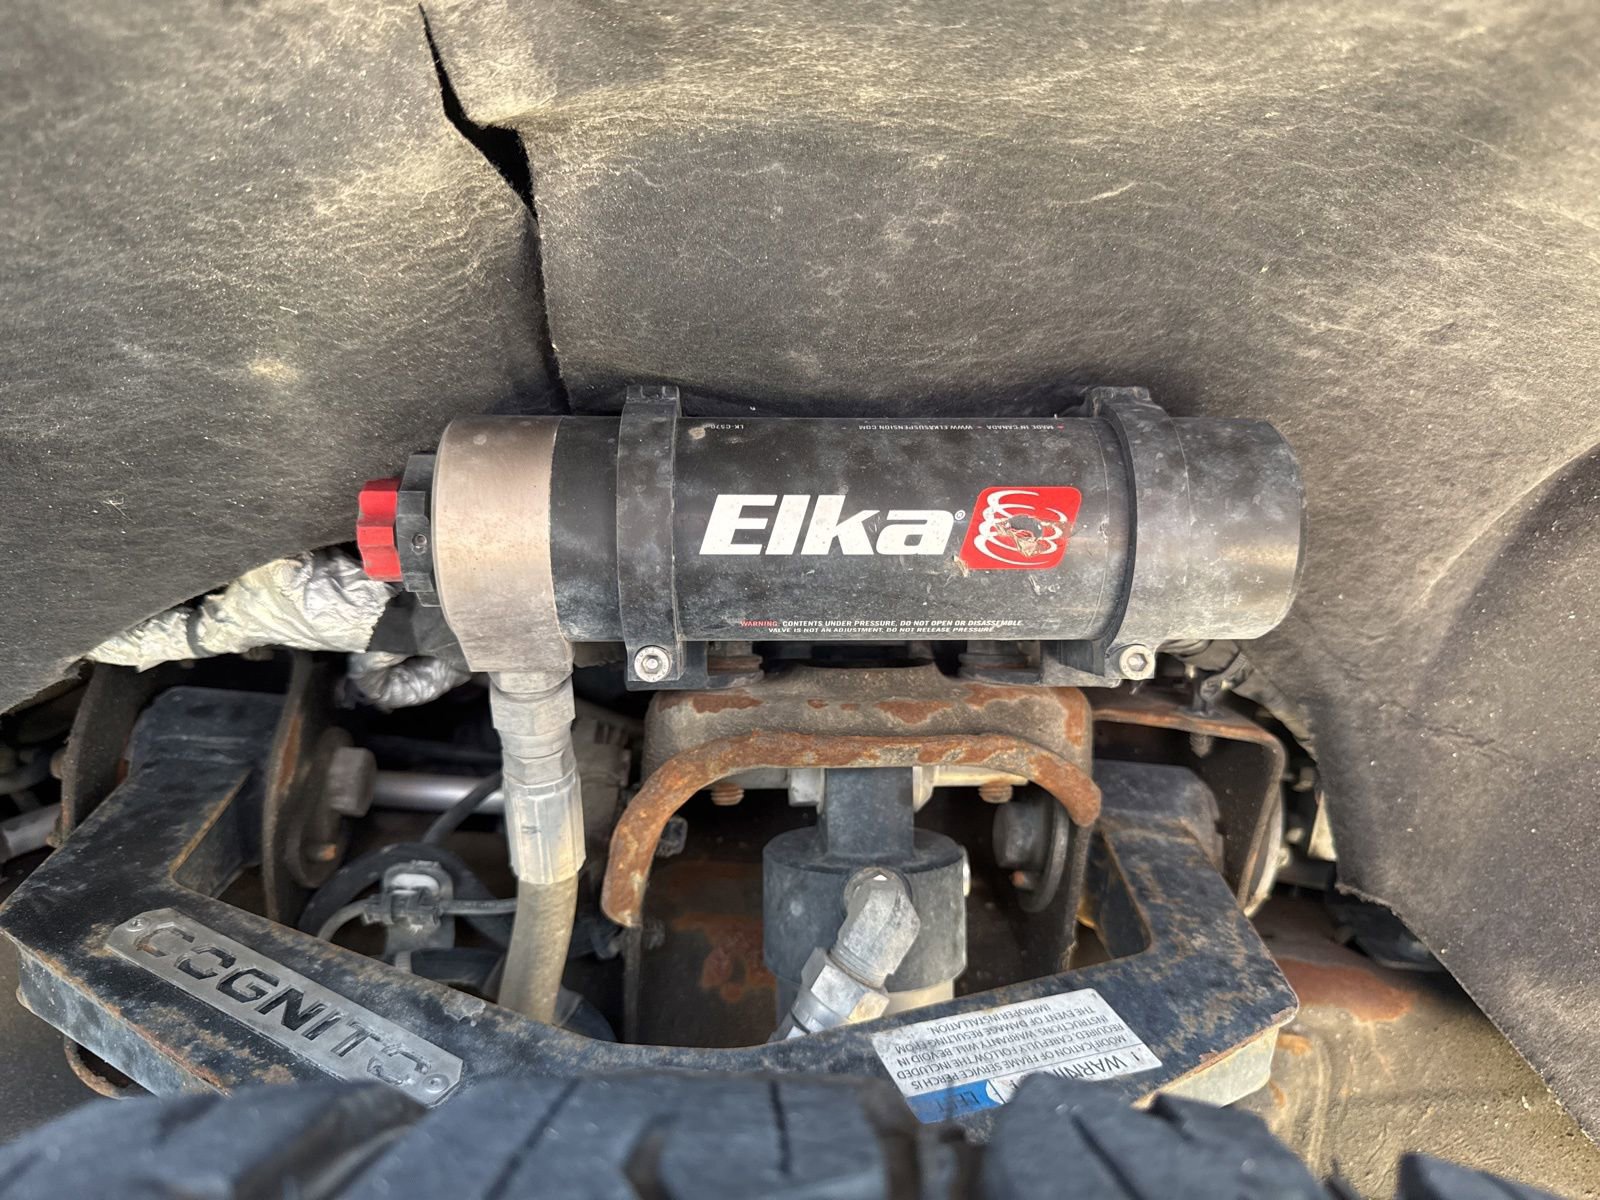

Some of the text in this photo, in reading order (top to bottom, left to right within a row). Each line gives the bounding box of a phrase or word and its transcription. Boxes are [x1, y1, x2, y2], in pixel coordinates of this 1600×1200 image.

[699, 494, 954, 555] Elka
[1000, 1003, 1051, 1019] IMPROPER
[895, 1006, 1095, 1055] THE EVENT OF DAMAGE RESULTING FROM
[980, 1030, 1037, 1048] WARRANTY
[952, 1043, 980, 1054] WILL
[1019, 1035, 1073, 1052] CAREFULLY
[911, 1051, 939, 1063] VOID
[938, 1047, 953, 1058] BE
[974, 1046, 1018, 1062] FOLLOW
[896, 1057, 910, 1067] IN
[896, 1060, 952, 1079] INCLUDED
[911, 1035, 1127, 1089] MODIFICATION OF FRAME SERVICE PERCH IS
[951, 1056, 975, 1067] THE
[1043, 1055, 1128, 1079] WARNI
[934, 1091, 980, 1113] LET
